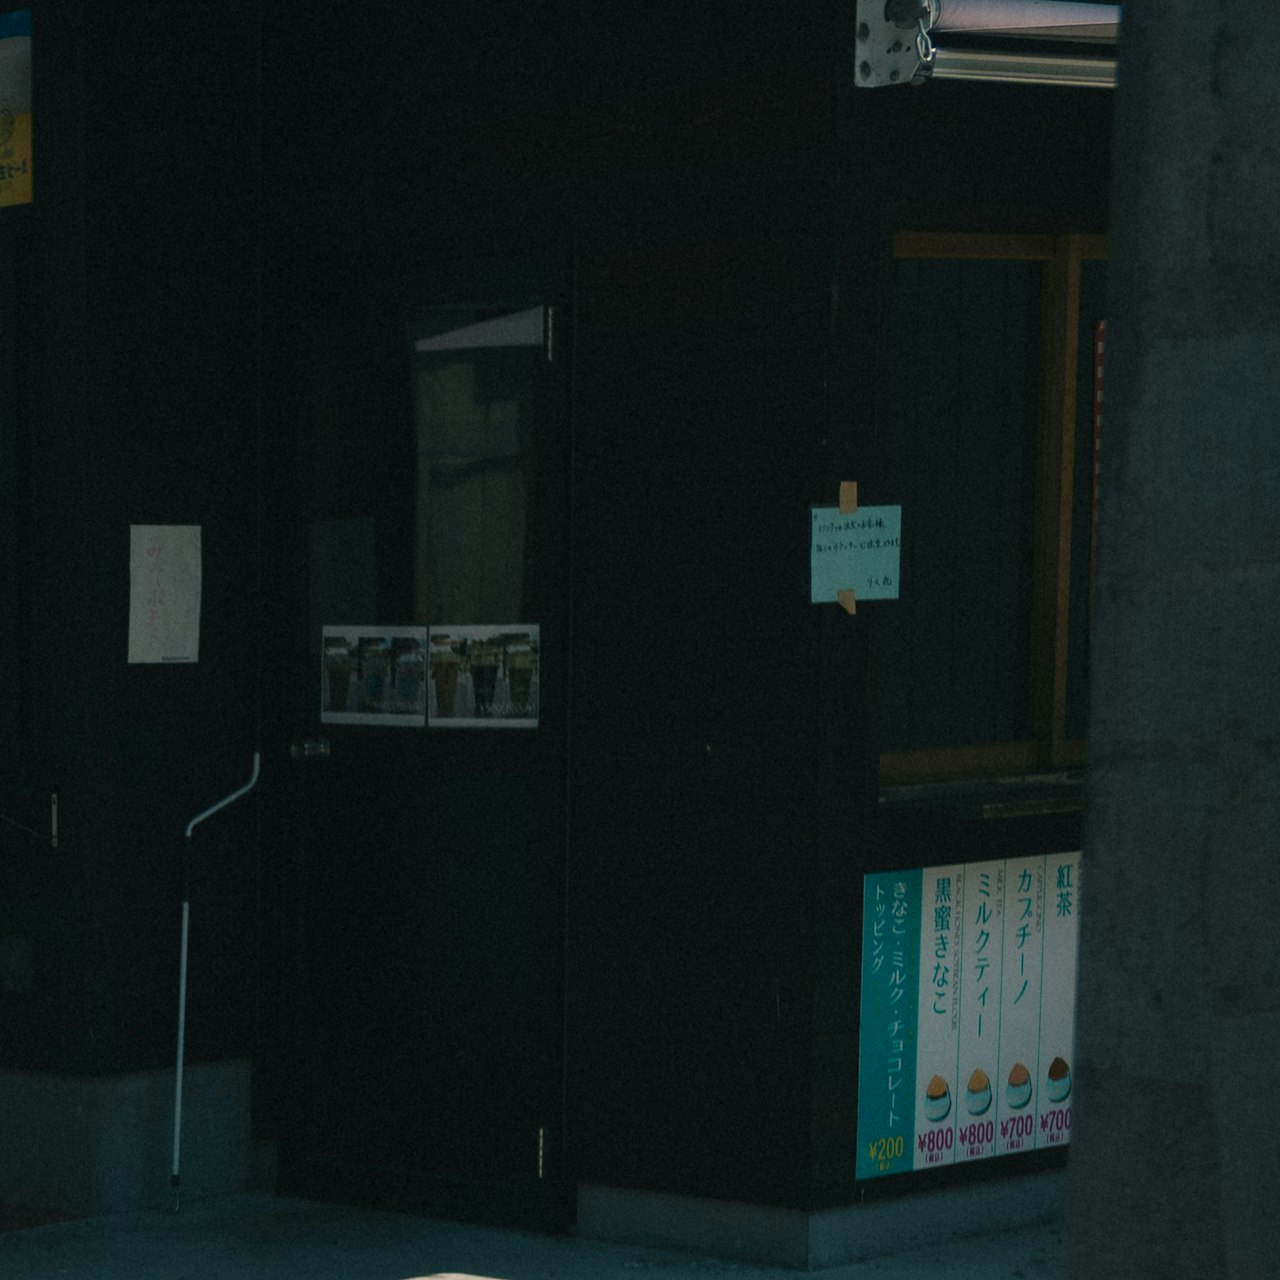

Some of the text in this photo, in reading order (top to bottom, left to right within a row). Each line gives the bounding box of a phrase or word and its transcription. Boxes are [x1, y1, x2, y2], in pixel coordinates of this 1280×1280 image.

[1055, 863, 1073, 917] 紅茶
[872, 883, 885, 975] トッピング
[932, 876, 952, 1016] 黒蜜きなこ
[974, 872, 992, 1038] ミルクティー
[1013, 867, 1033, 1006] カプチーノ
[868, 1136, 905, 1161] ¥200
[918, 1127, 954, 1152] ¥800
[959, 1120, 994, 1145] ¥800
[1000, 1114, 1034, 1139] ¥700
